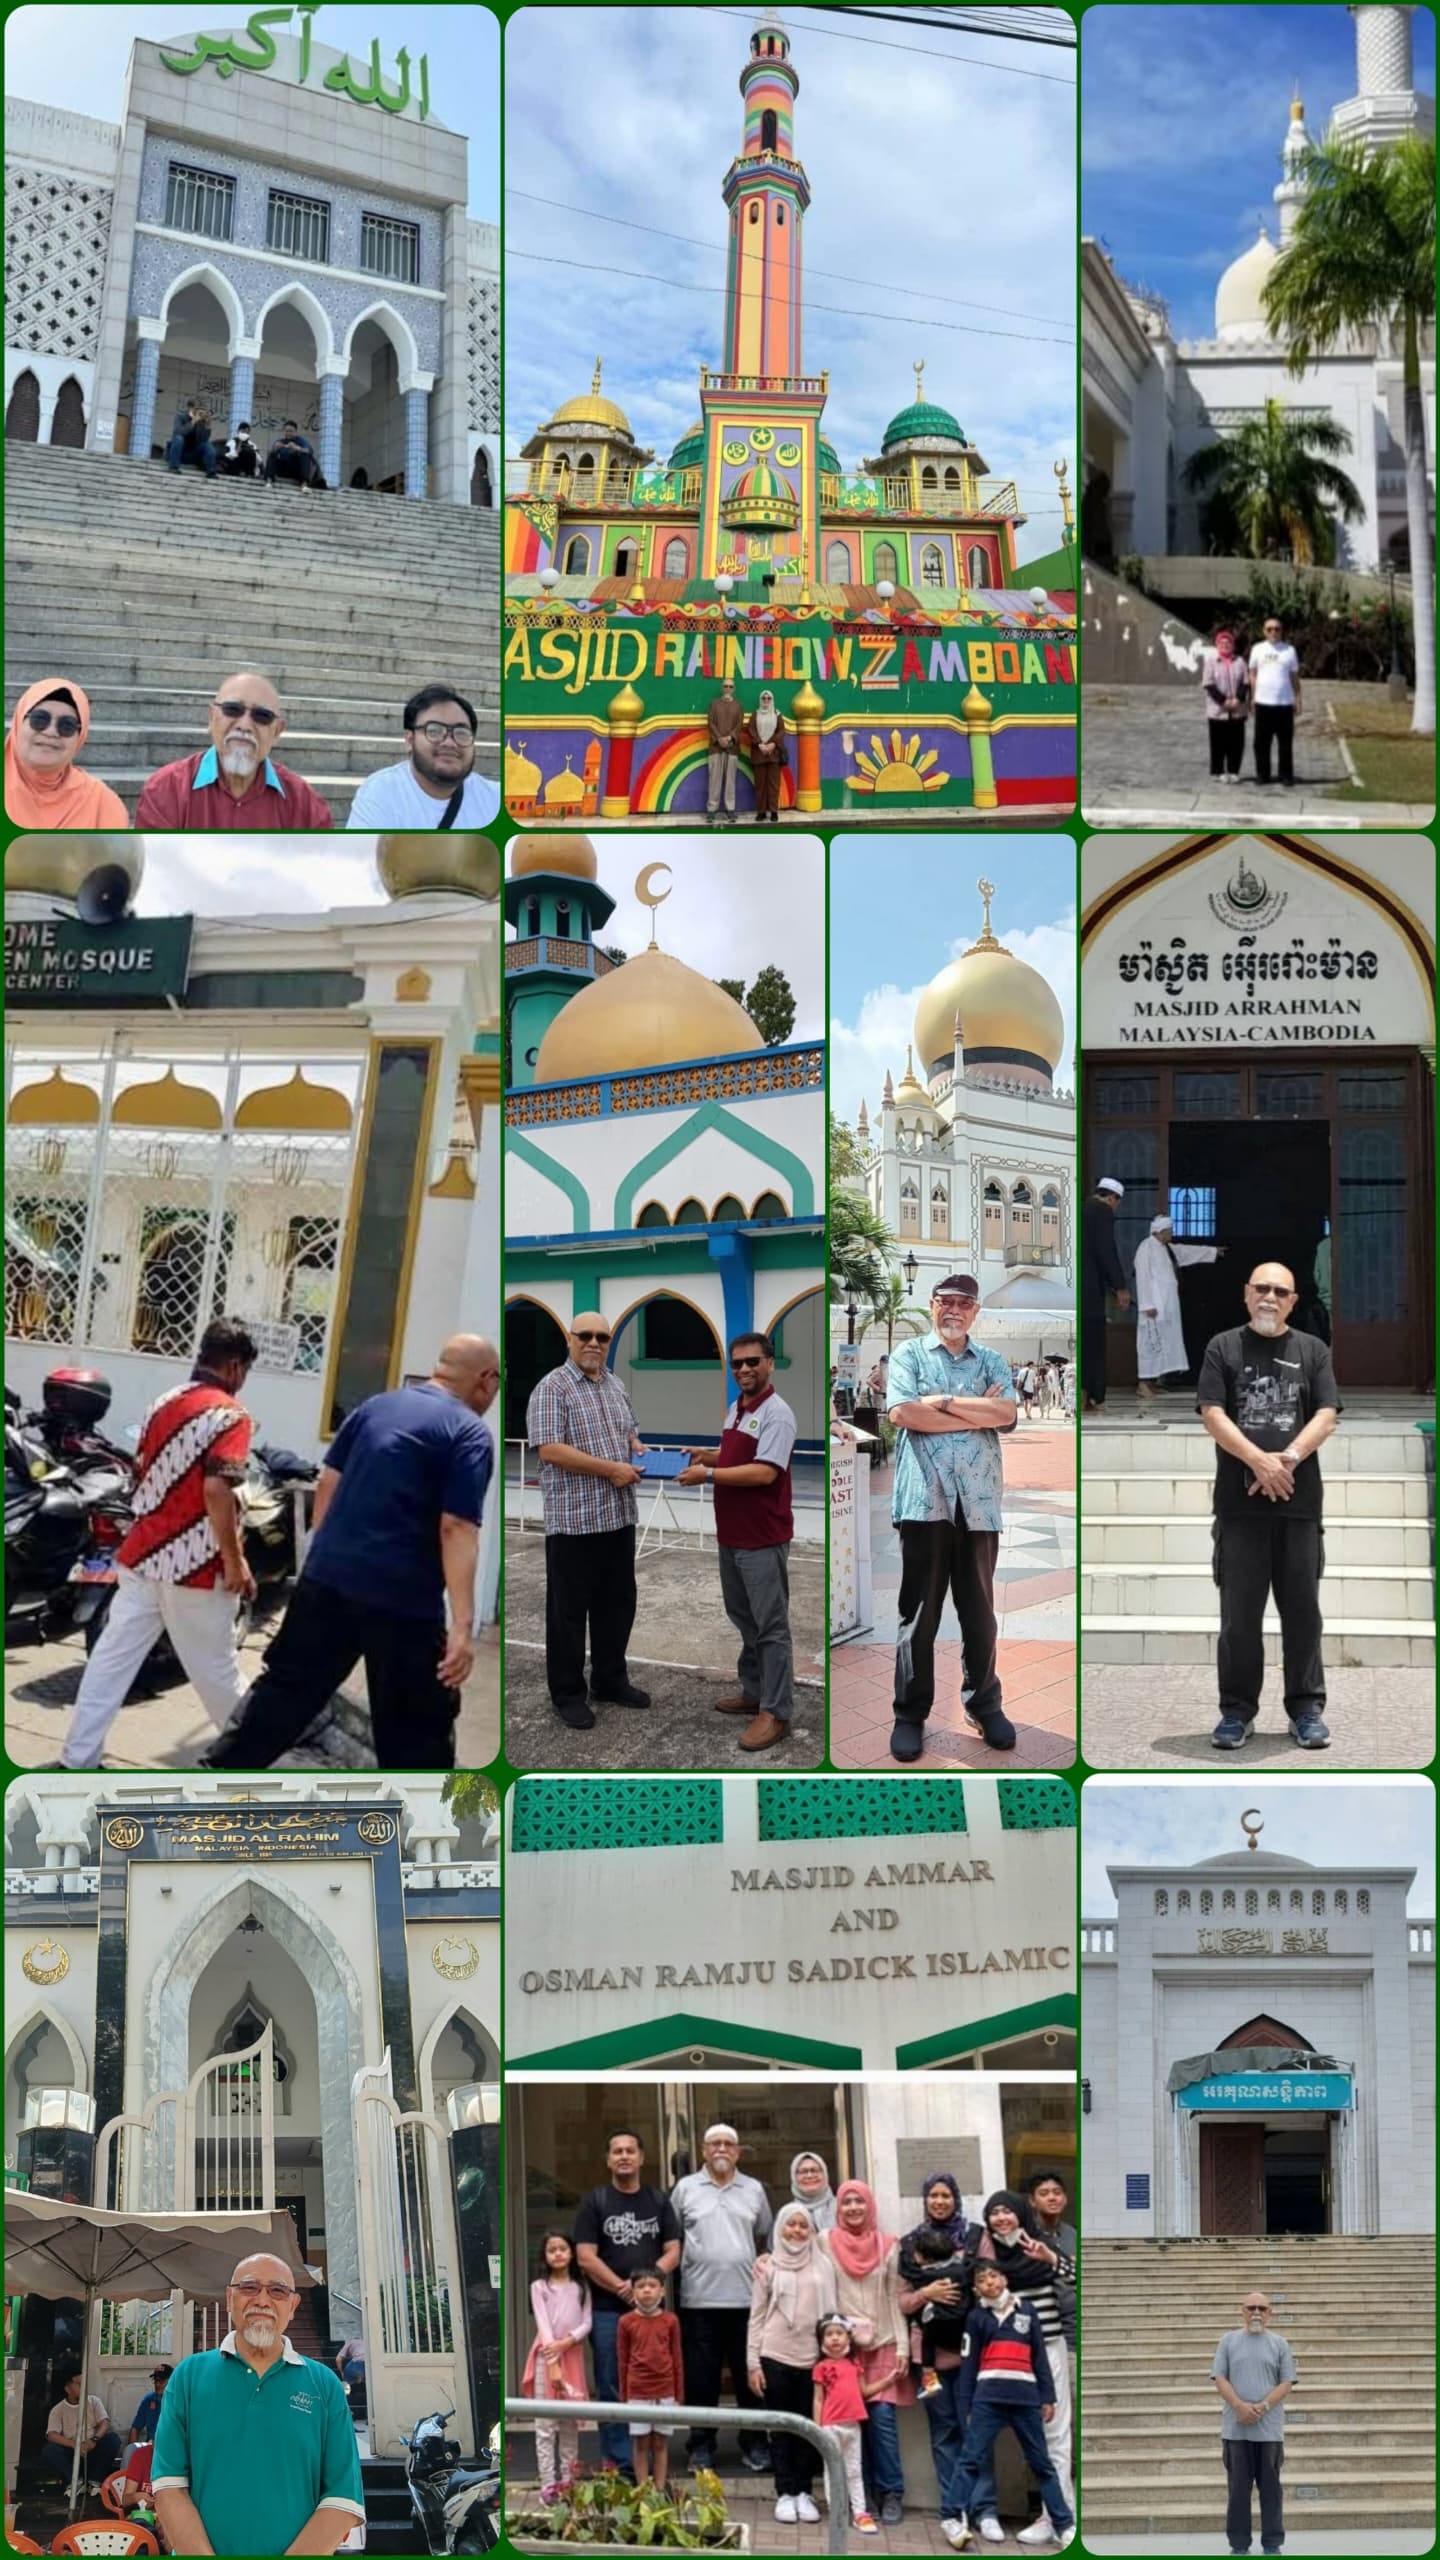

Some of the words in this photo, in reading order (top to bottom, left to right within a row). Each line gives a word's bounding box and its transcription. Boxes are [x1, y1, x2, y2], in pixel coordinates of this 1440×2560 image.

[323, 37, 430, 122] الله
[859, 634, 1077, 690] ZAMBOAN
[43, 948, 153, 974] MOSQUE
[6, 974, 80, 989] CENTER
[1134, 1001, 1219, 1017] MASJID
[1224, 999, 1362, 1016] ARRAHMAN
[1119, 1025, 1376, 1043] MALAYSIA-CAMBODIA
[171, 1834, 246, 1844] MASJID
[249, 1834, 274, 1843] AL
[278, 1833, 340, 1842] RAHIM
[731, 1866, 855, 1892] MASJID
[864, 1859, 994, 1887] AMMAR
[830, 1908, 899, 1932] AND
[519, 1966, 643, 1994] OSMAN
[655, 1960, 776, 1988] RAMJU
[788, 1955, 917, 1984] SADICK
[926, 1946, 1070, 1976] ISLAMIC
